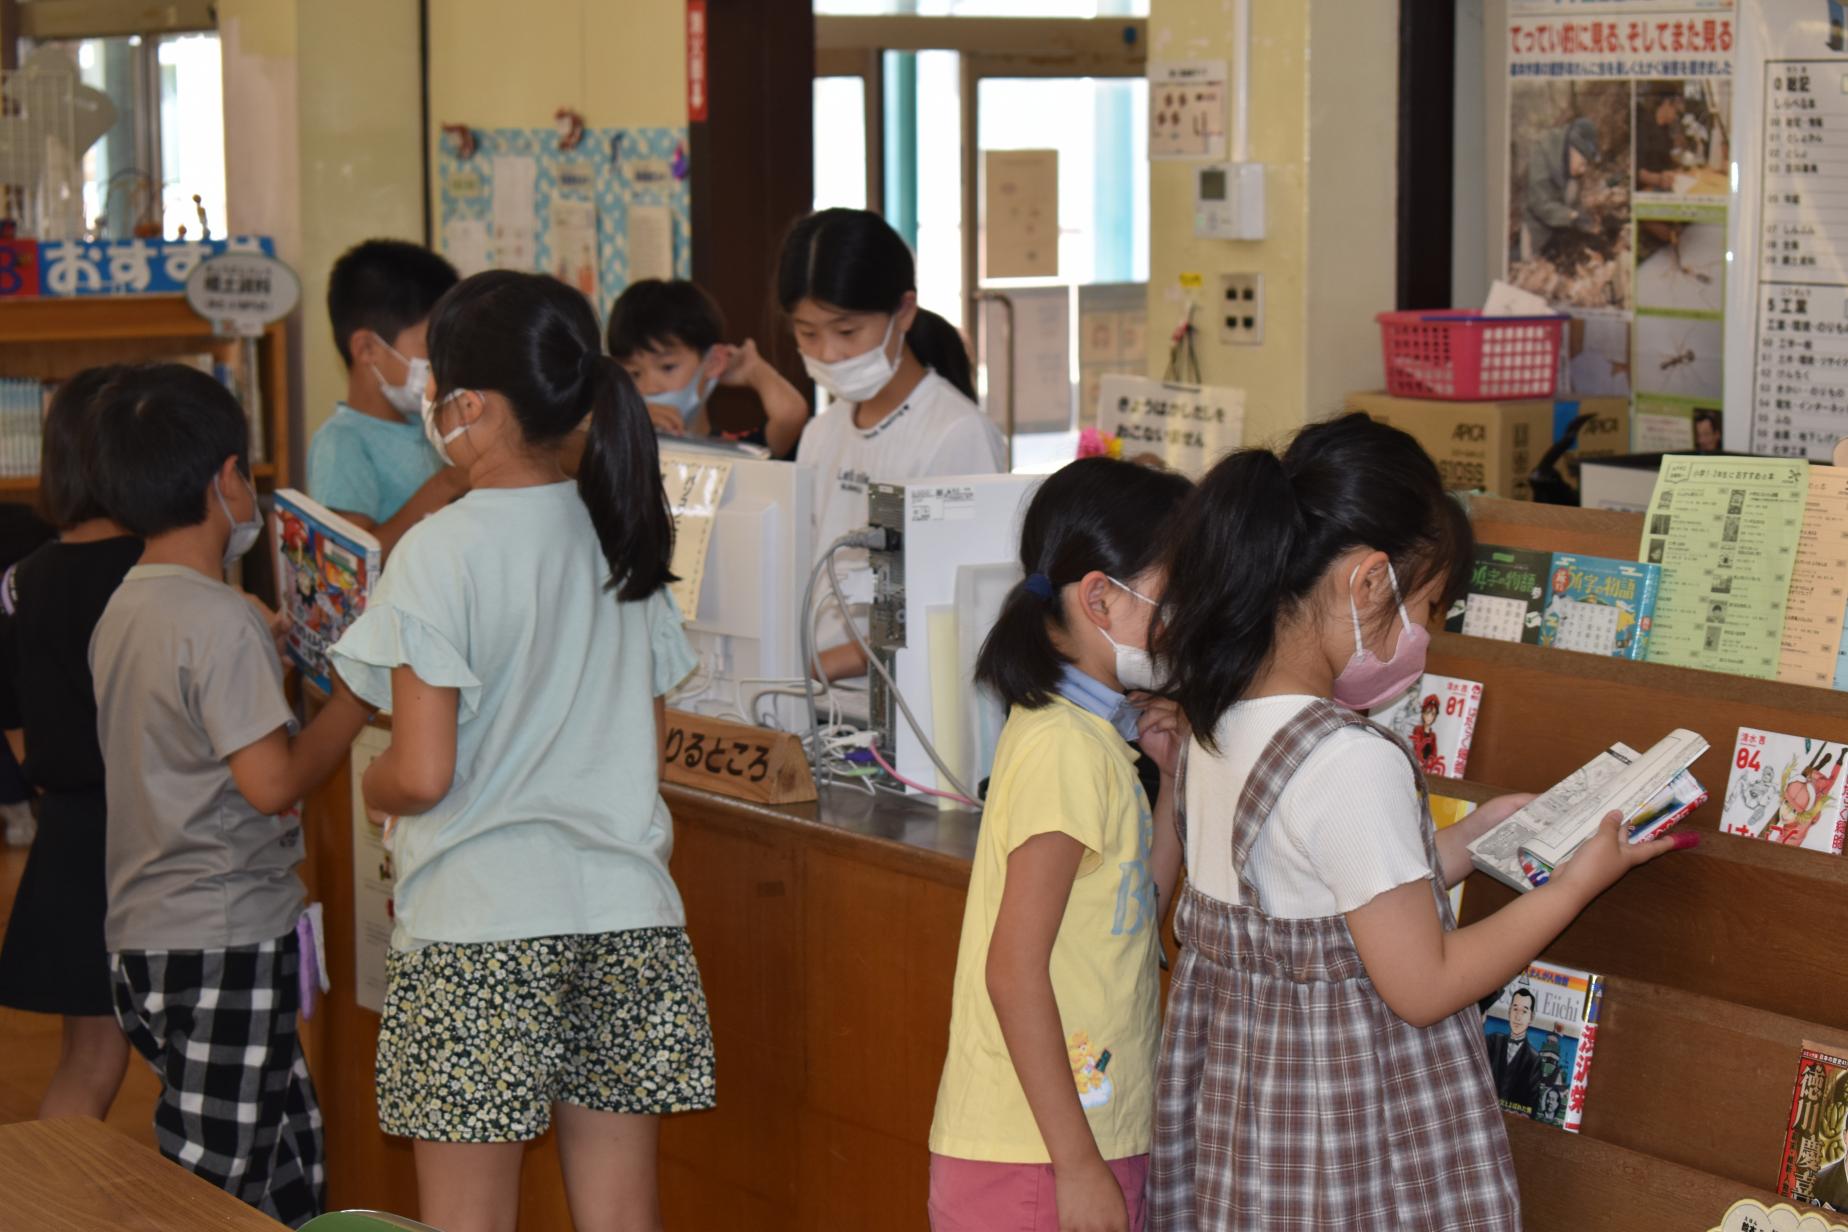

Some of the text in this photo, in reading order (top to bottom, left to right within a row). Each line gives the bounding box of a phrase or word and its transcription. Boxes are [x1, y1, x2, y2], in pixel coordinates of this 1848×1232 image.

[46, 236, 262, 295] おすす
[1542, 991, 1580, 1024] Eiichi
